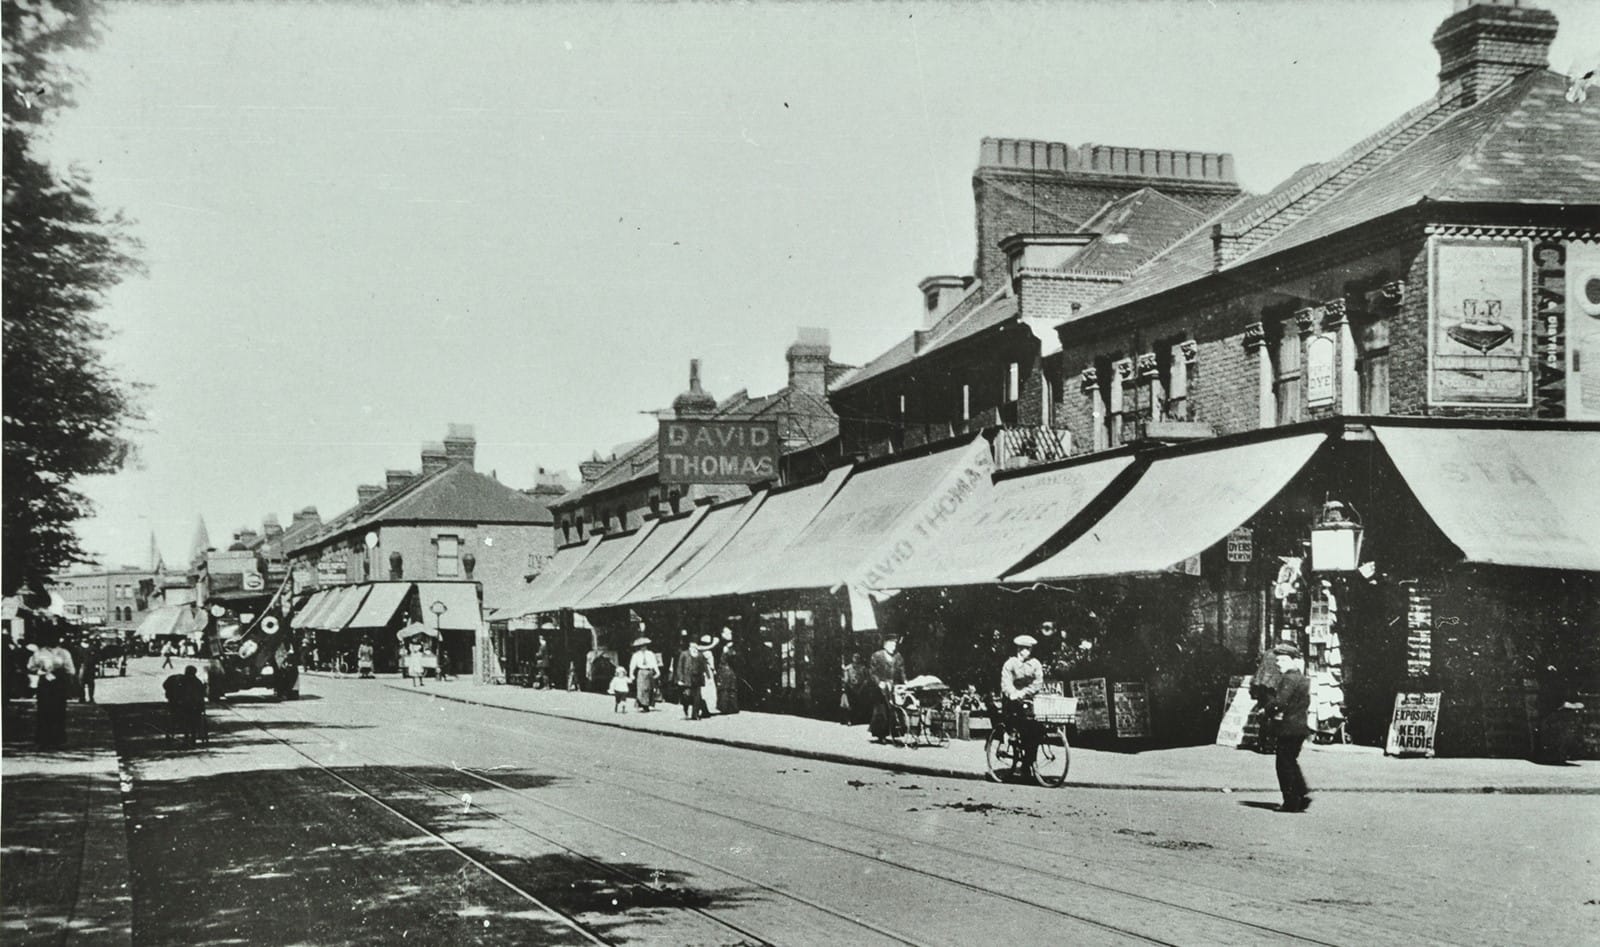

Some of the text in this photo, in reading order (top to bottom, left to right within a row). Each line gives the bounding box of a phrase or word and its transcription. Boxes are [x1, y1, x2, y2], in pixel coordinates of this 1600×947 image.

[1534, 242, 1566, 418] CLAPHAM
[668, 425, 770, 446] DAVID
[664, 454, 774, 476] THOMAS
[1396, 710, 1436, 721] EXPOSURE
[1399, 725, 1425, 736] KEIR
[1396, 736, 1432, 749] HARDIE
